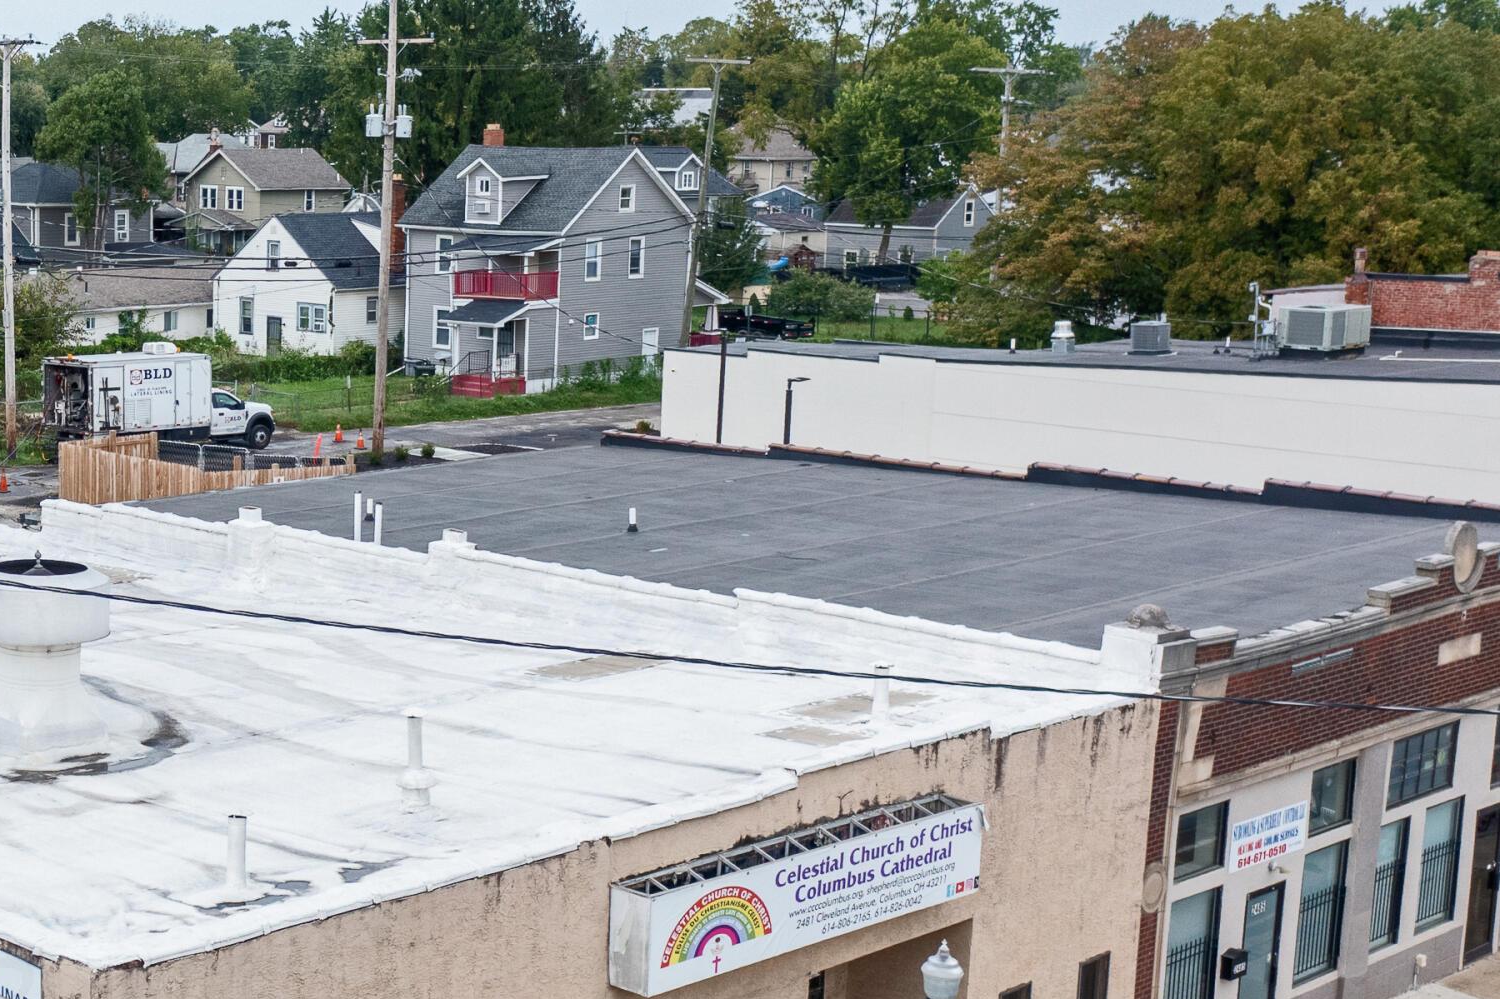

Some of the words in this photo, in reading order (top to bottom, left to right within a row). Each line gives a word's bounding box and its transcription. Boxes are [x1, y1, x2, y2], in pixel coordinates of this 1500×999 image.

[143, 368, 173, 380] BLD
[775, 852, 844, 888] Celestial
[850, 836, 904, 866] Church
[910, 828, 926, 849] of
[930, 816, 973, 842] Christ
[795, 868, 875, 903] Columbus
[880, 842, 952, 877] Cathedral
[662, 905, 701, 964] CELESTIAL
[701, 887, 740, 906] CHURCH
[740, 888, 752, 900] OF
[751, 897, 771, 930] CHRIST
[689, 916, 700, 928] DU
[816, 904, 850, 924] Cleveland
[879, 888, 912, 908] Columbus
[913, 883, 925, 896] OH
